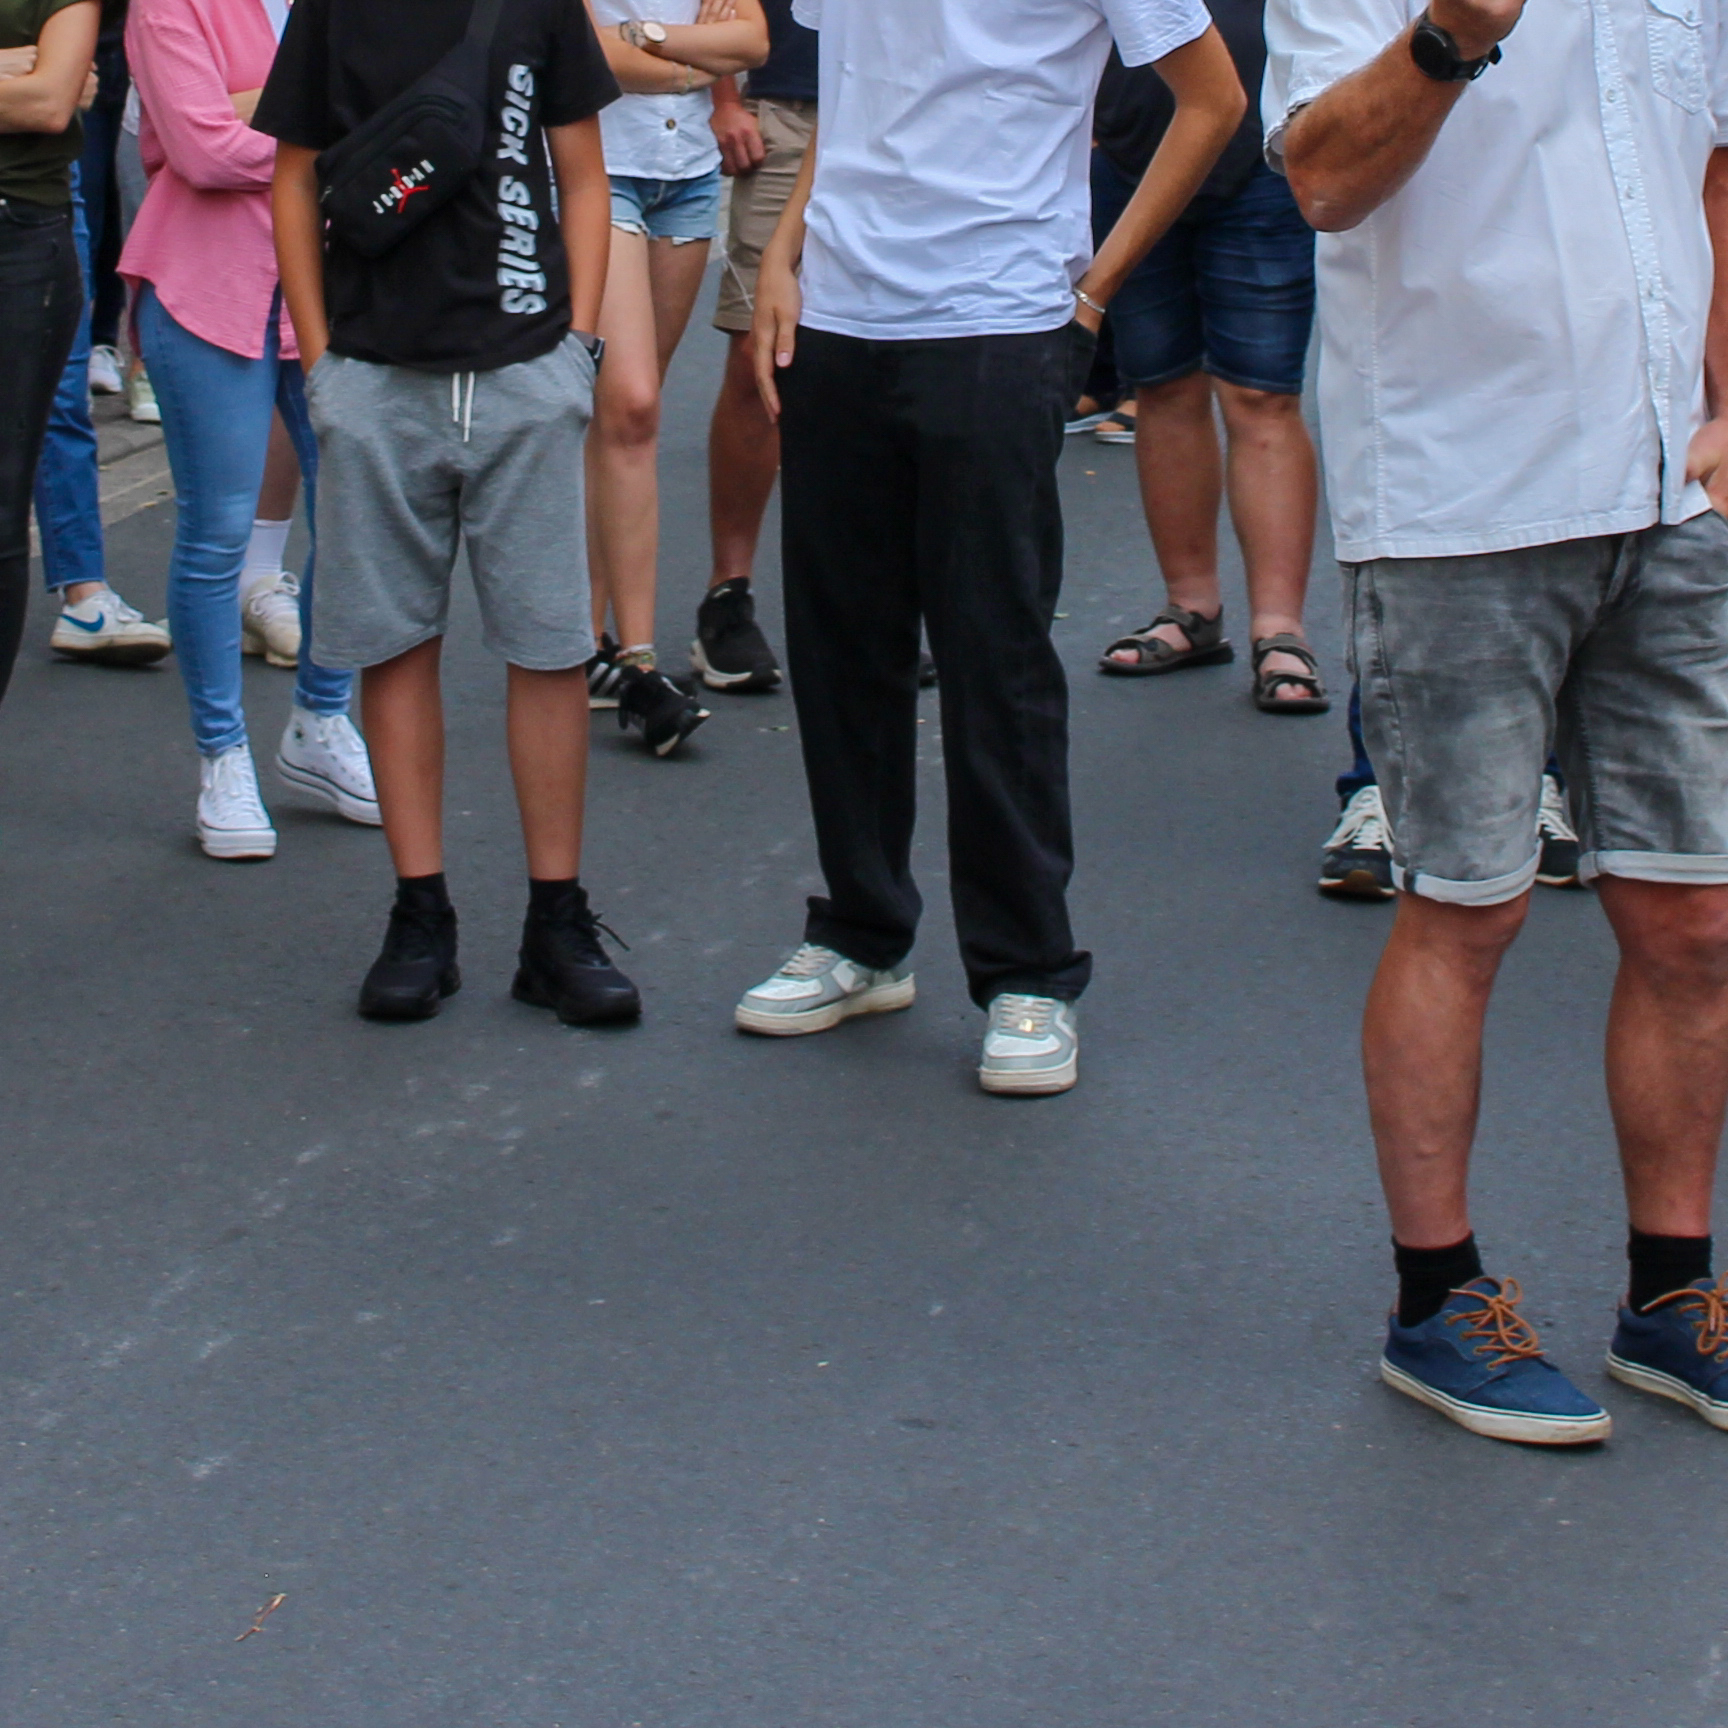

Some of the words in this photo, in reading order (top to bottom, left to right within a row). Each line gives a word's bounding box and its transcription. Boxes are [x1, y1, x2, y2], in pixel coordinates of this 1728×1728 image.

[496, 63, 535, 166] SICK
[372, 159, 435, 214] JORDAN
[496, 175, 547, 315] SERIES
